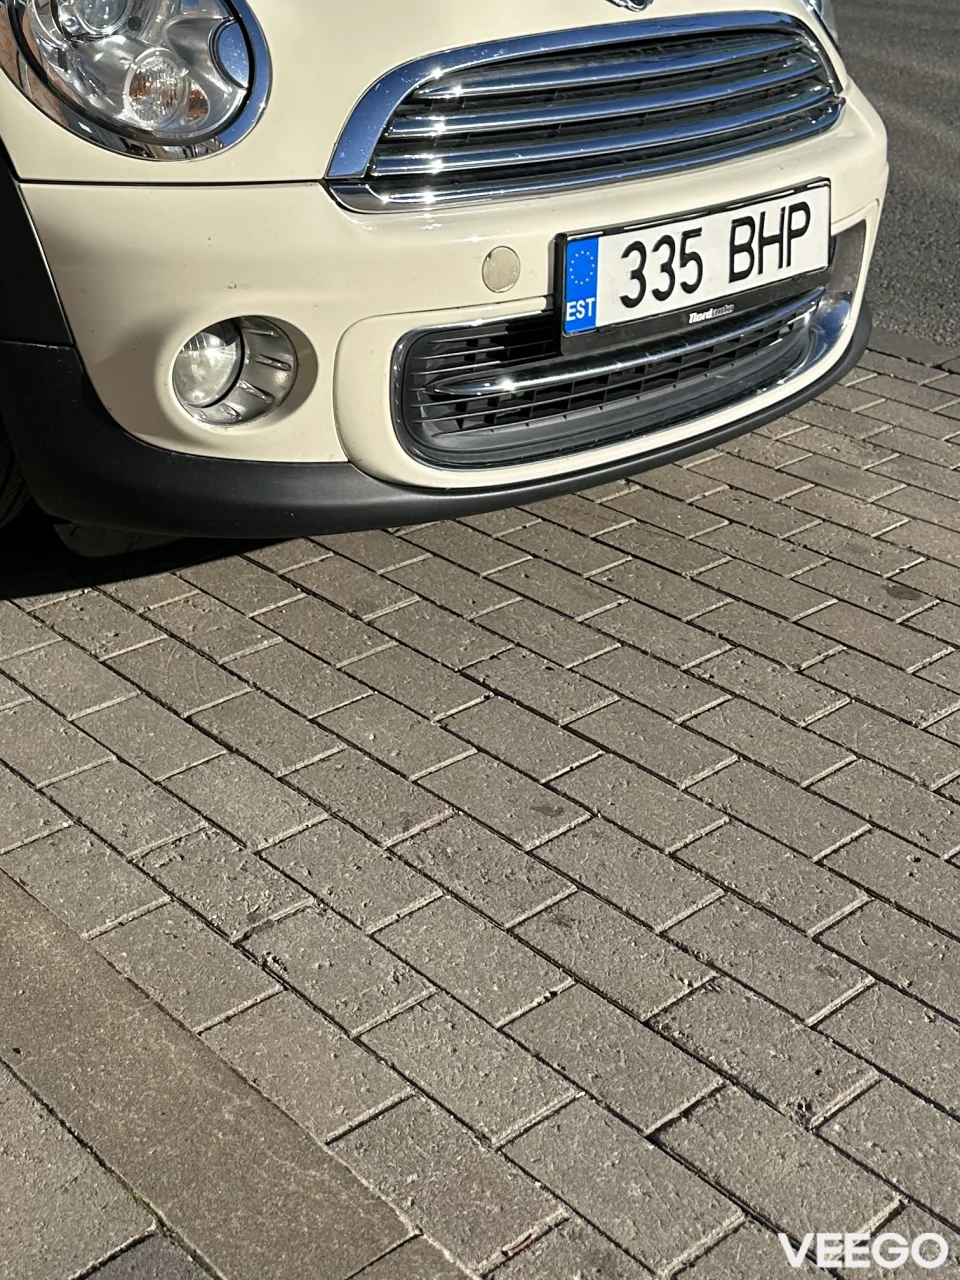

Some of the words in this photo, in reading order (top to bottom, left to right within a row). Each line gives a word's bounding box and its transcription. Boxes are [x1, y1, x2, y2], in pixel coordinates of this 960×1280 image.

[620, 227, 703, 308] 335
[729, 201, 811, 283] BHP
[566, 297, 595, 321] EST
